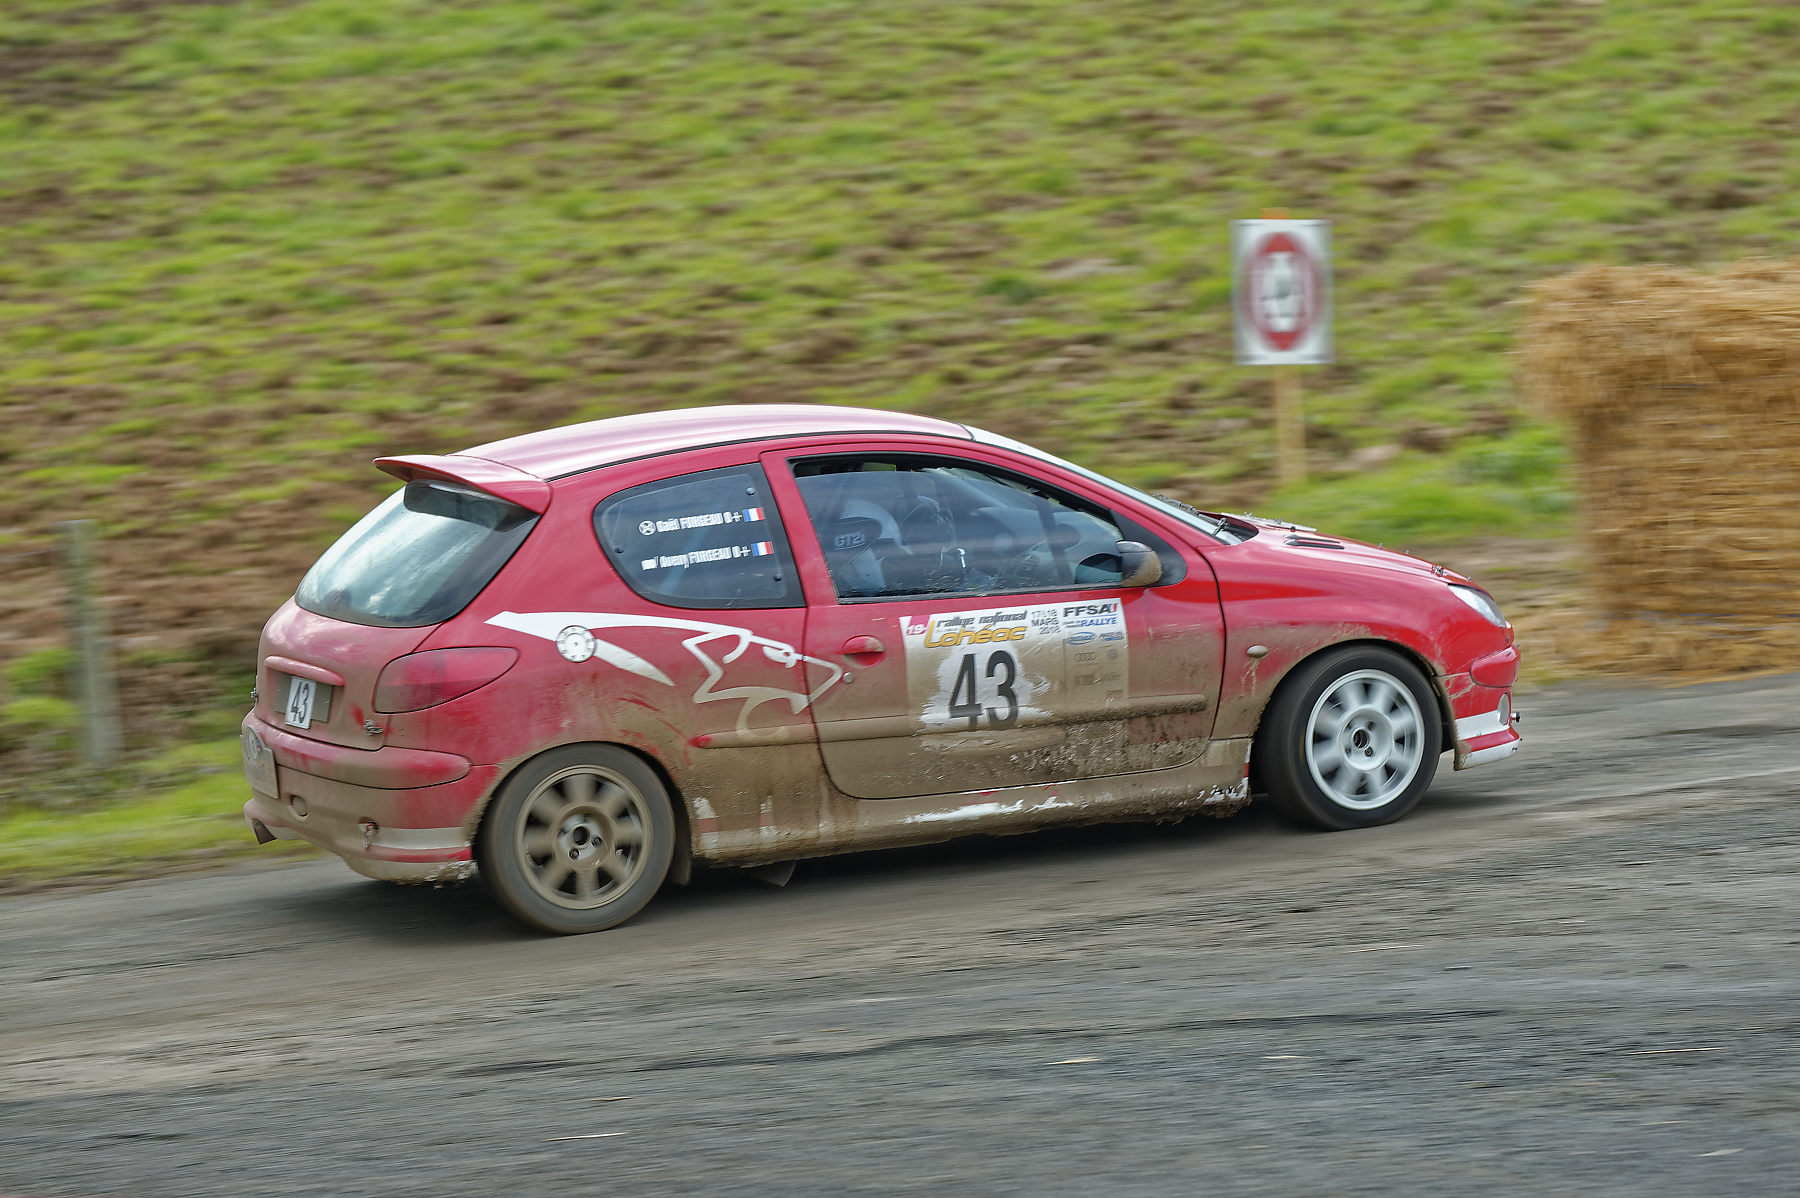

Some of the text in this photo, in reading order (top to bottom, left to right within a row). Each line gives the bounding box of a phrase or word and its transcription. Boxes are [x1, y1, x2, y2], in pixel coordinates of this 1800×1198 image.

[937, 610, 1028, 628] rallye national
[1063, 603, 1113, 618] FFSA
[1031, 616, 1060, 627] MARS
[1080, 617, 1118, 627] RALLYE
[924, 619, 1028, 648] Lohéac
[949, 649, 1019, 731] 43
[290, 681, 311, 724] 43
